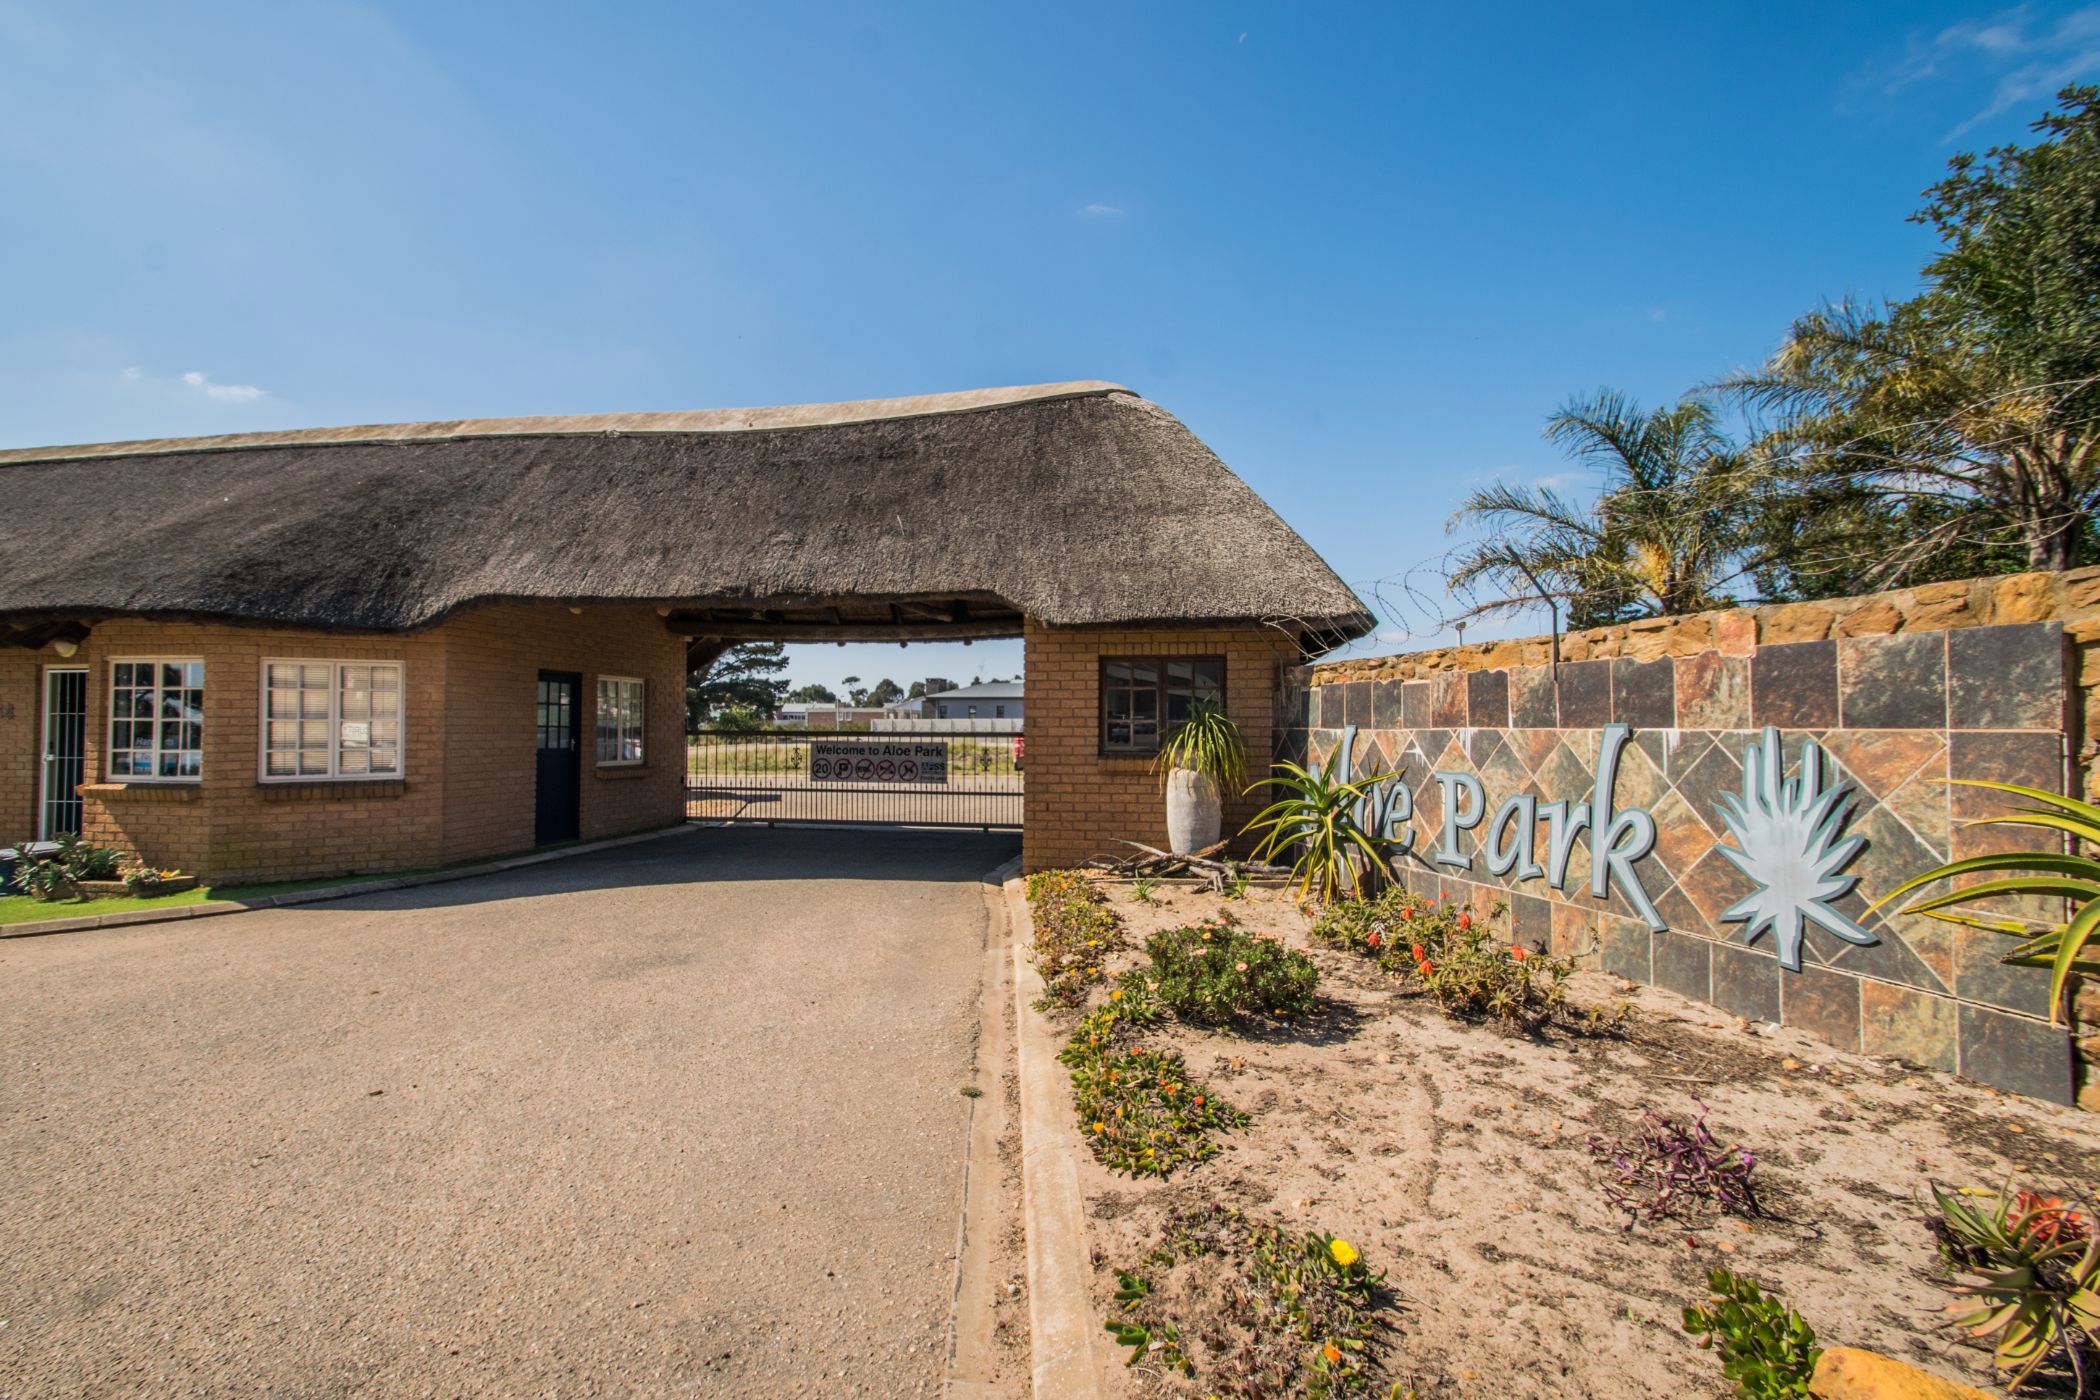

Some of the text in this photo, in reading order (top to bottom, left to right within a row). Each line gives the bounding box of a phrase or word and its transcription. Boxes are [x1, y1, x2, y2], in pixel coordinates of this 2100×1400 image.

[816, 744, 943, 757] Welcome to Aloe Park
[815, 763, 829, 774] 20
[1434, 723, 1669, 933] Park
